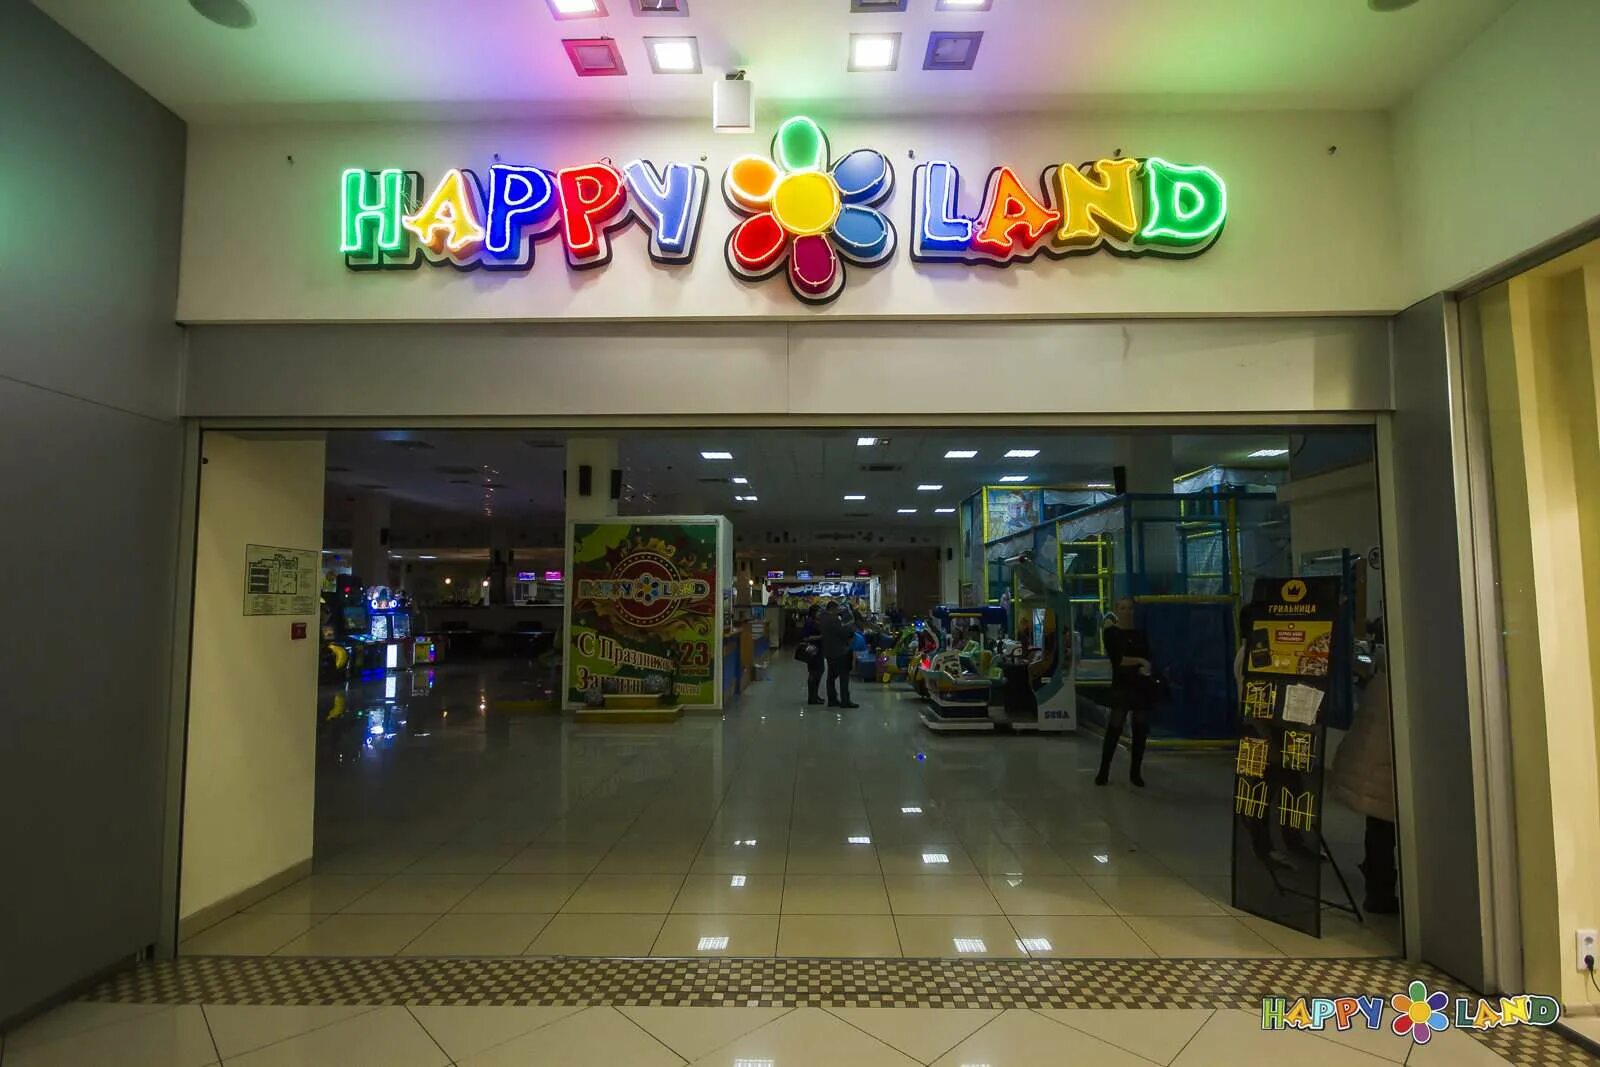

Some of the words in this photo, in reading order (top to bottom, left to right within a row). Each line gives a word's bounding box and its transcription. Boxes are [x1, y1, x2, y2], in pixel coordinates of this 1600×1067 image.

[340, 159, 702, 263] HAPPY
[916, 157, 1228, 261] LAND
[577, 632, 595, 656] С
[679, 642, 710, 666] 23
